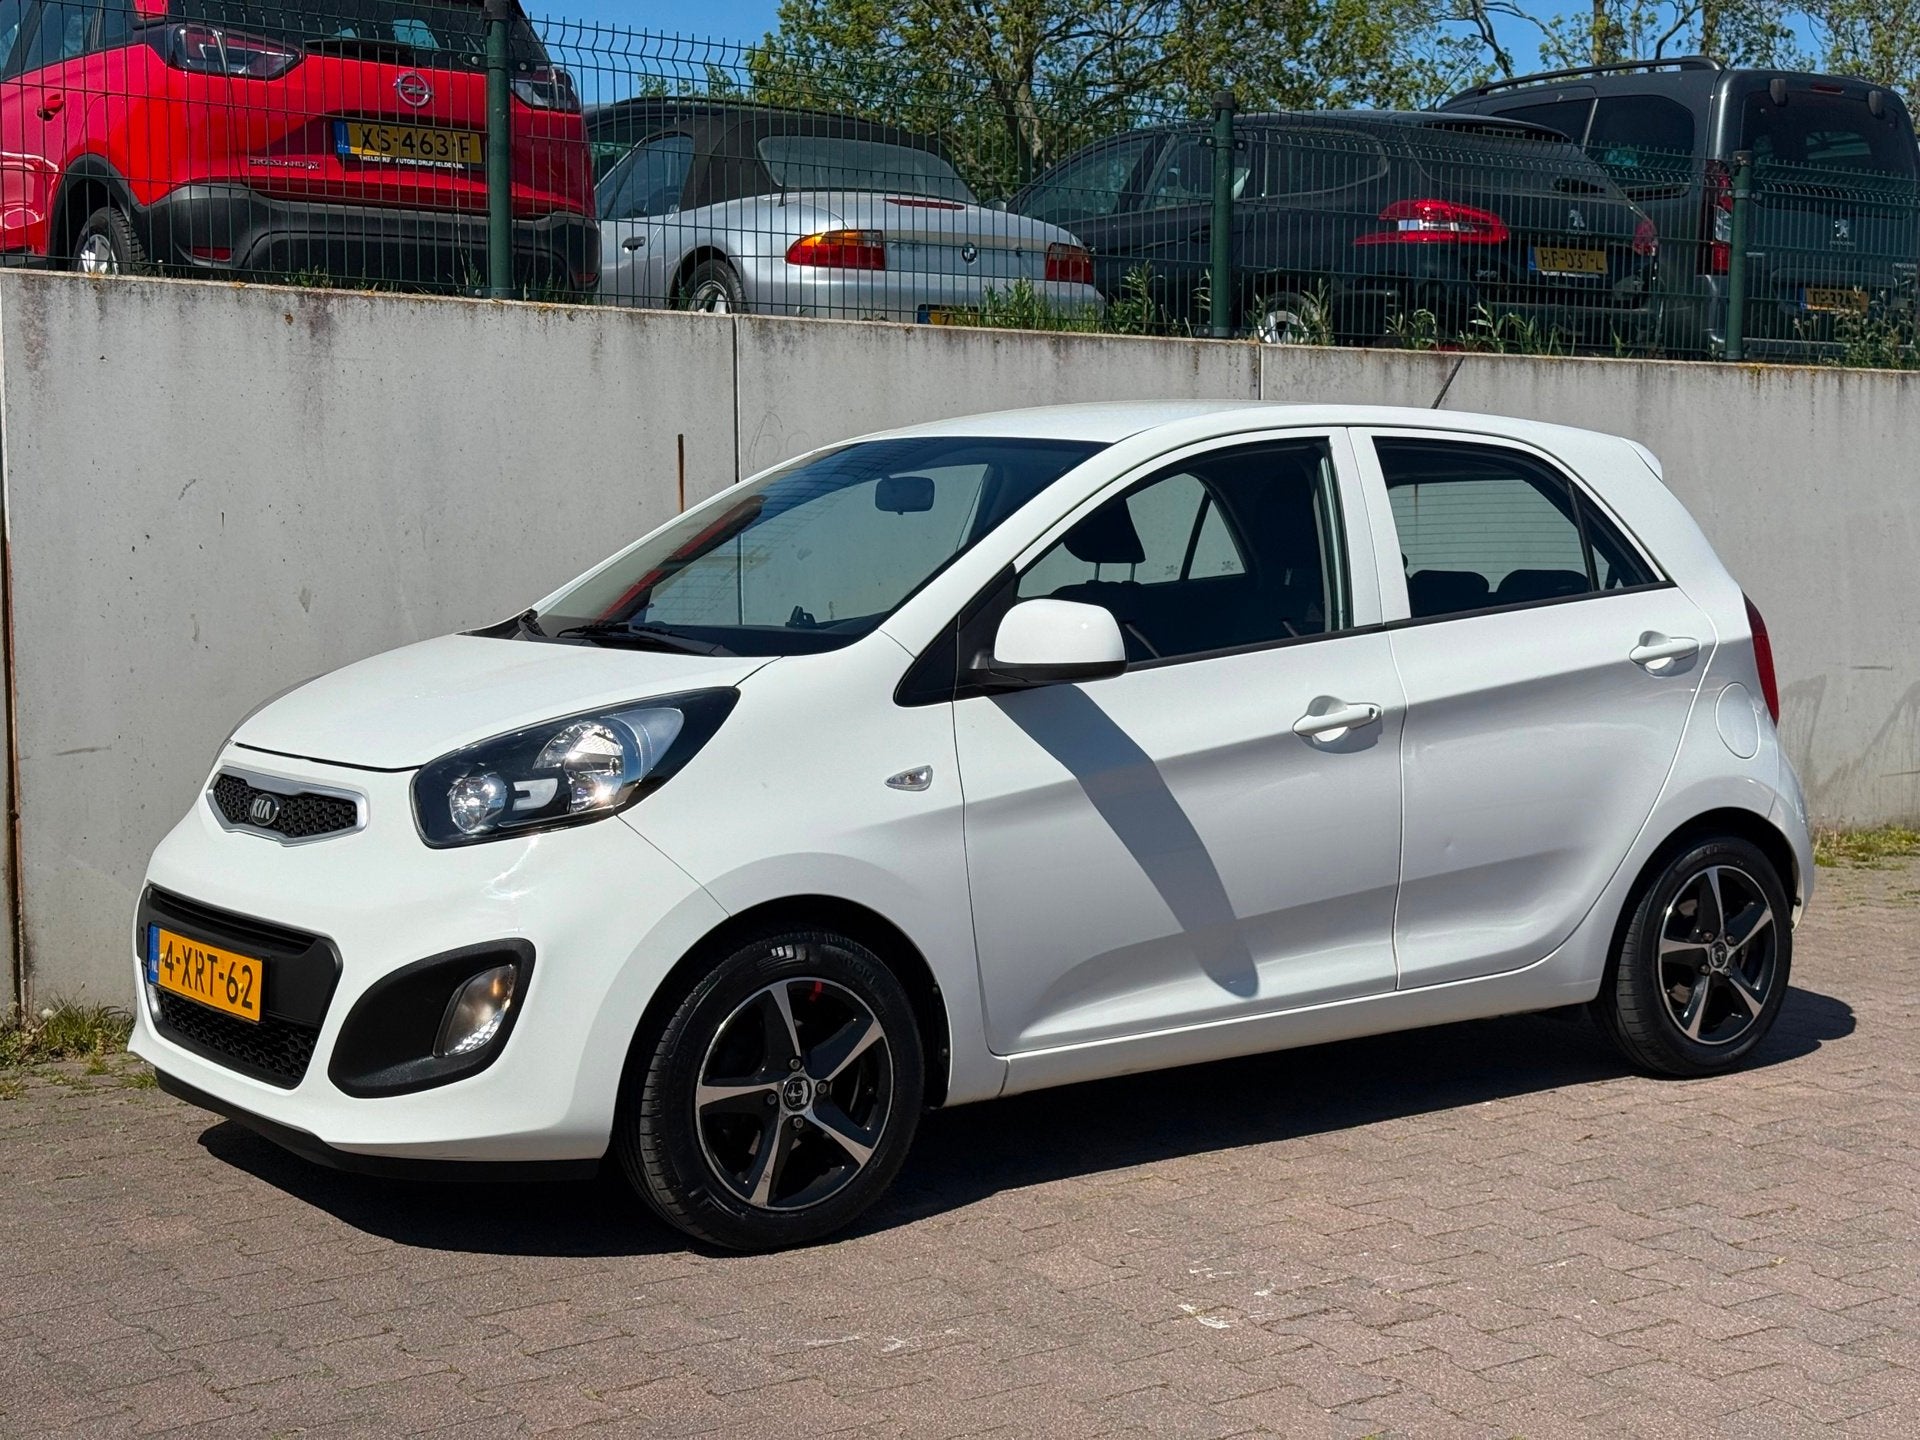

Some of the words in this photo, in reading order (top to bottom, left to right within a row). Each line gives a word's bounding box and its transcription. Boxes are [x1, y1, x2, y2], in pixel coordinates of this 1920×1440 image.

[359, 126, 471, 158] XS-463-F
[251, 798, 271, 820] KIA
[163, 940, 253, 1010] 4-XRT-62
